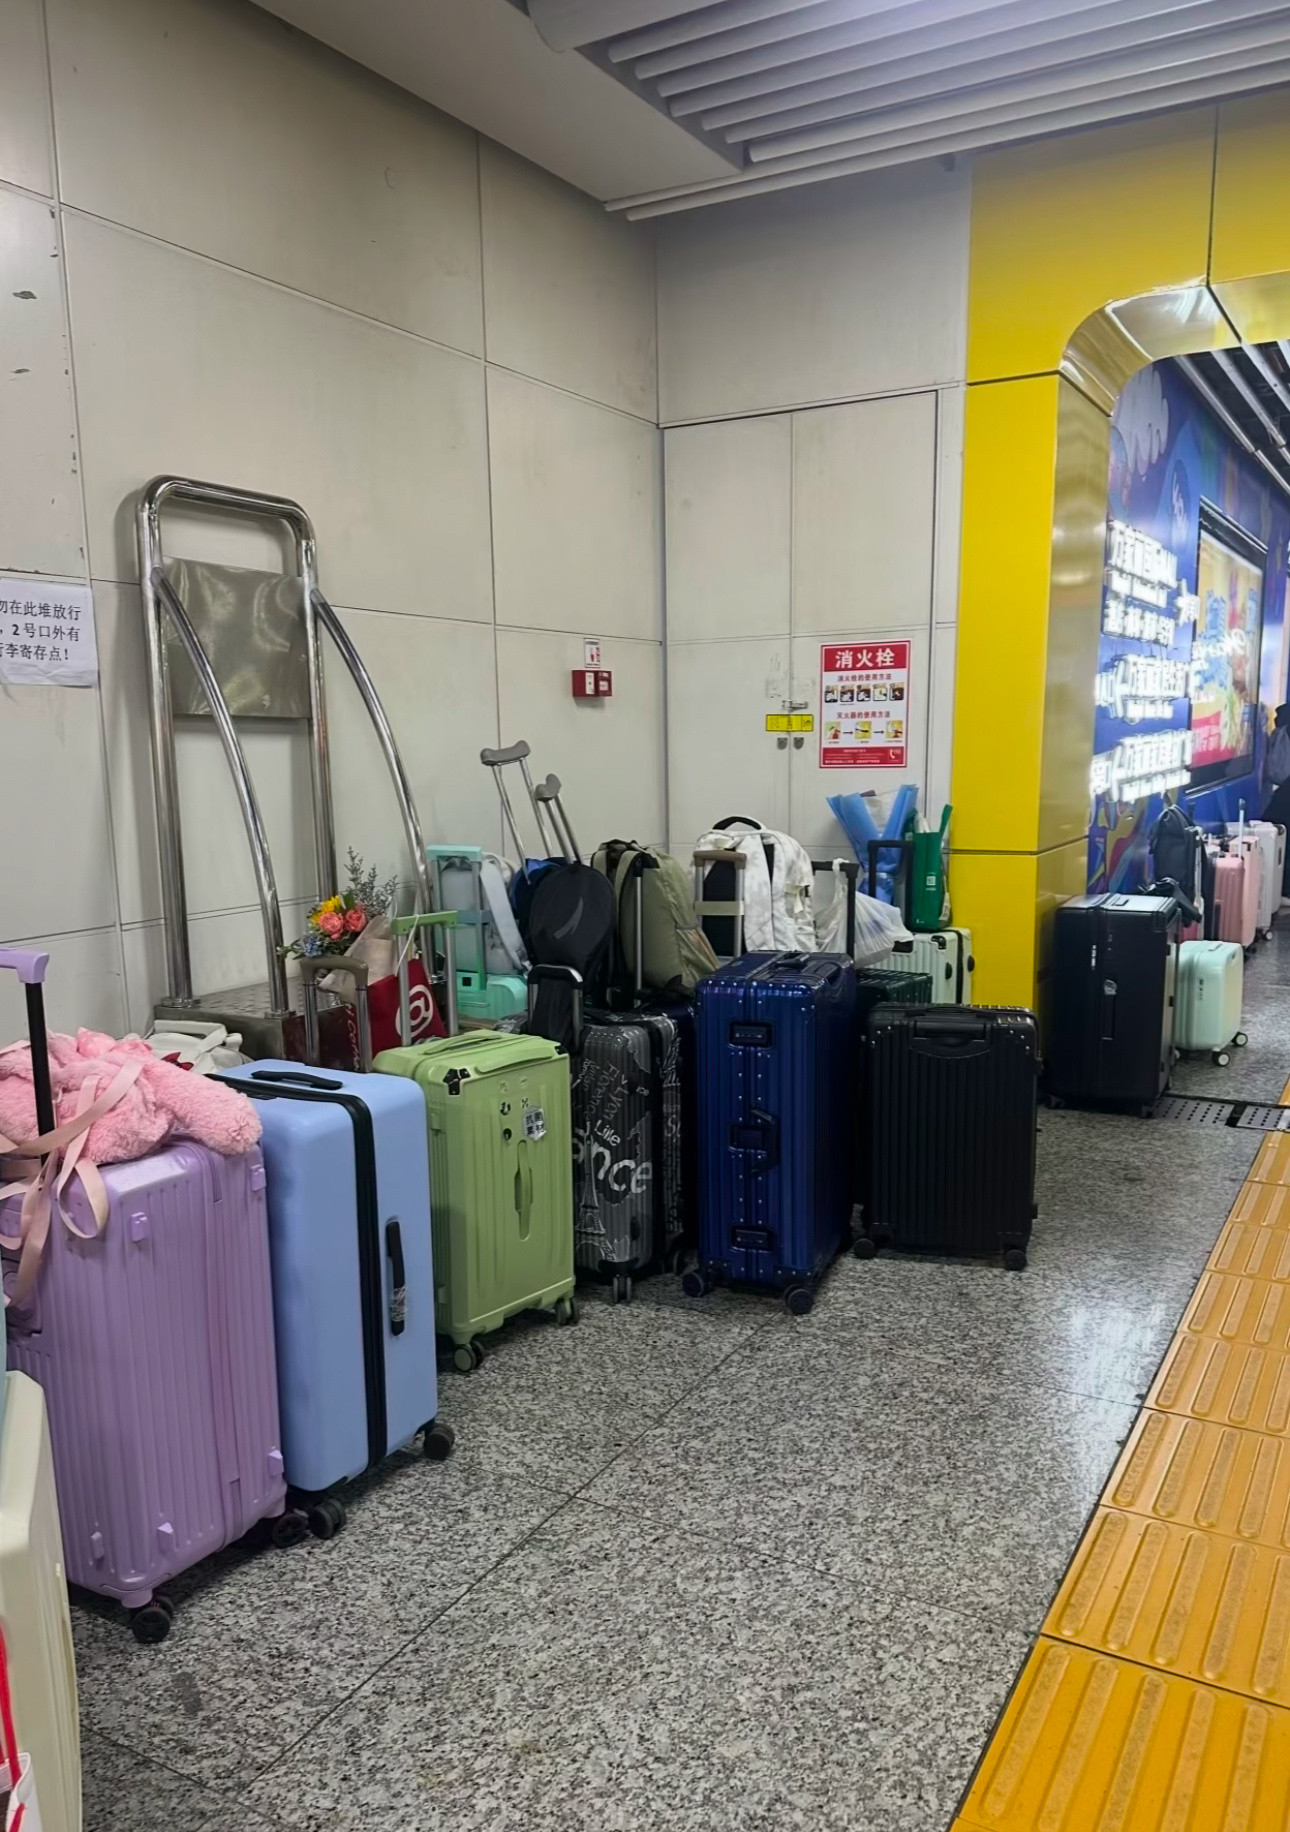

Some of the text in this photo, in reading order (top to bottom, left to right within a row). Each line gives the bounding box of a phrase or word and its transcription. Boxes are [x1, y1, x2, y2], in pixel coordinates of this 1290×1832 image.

[0, 600, 81, 620] 勿在此堆放行
[835, 647, 895, 669] 消火栓
[837, 710, 890, 719] 灭火器的使用方法
